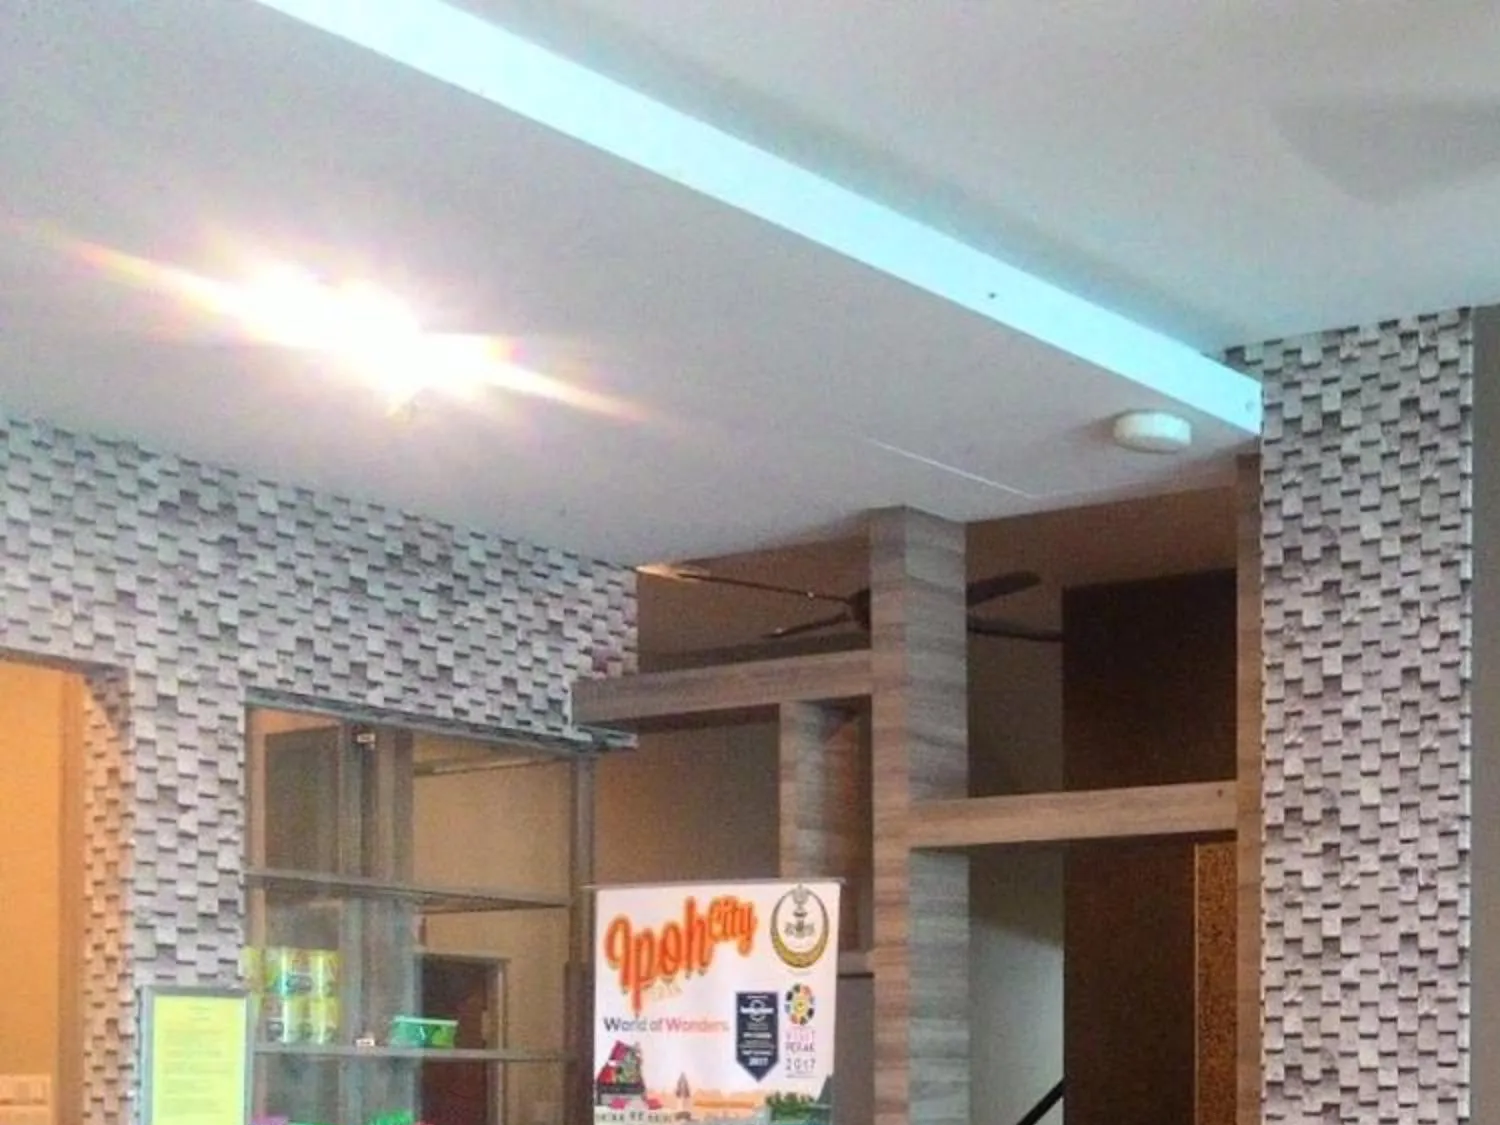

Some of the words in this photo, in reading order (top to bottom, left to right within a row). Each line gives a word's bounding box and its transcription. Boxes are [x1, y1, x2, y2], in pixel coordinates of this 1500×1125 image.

[604, 895, 713, 1018] Ipoh
[603, 1017, 648, 1033] World
[649, 1017, 663, 1033] of
[664, 1017, 730, 1034] Wonders
